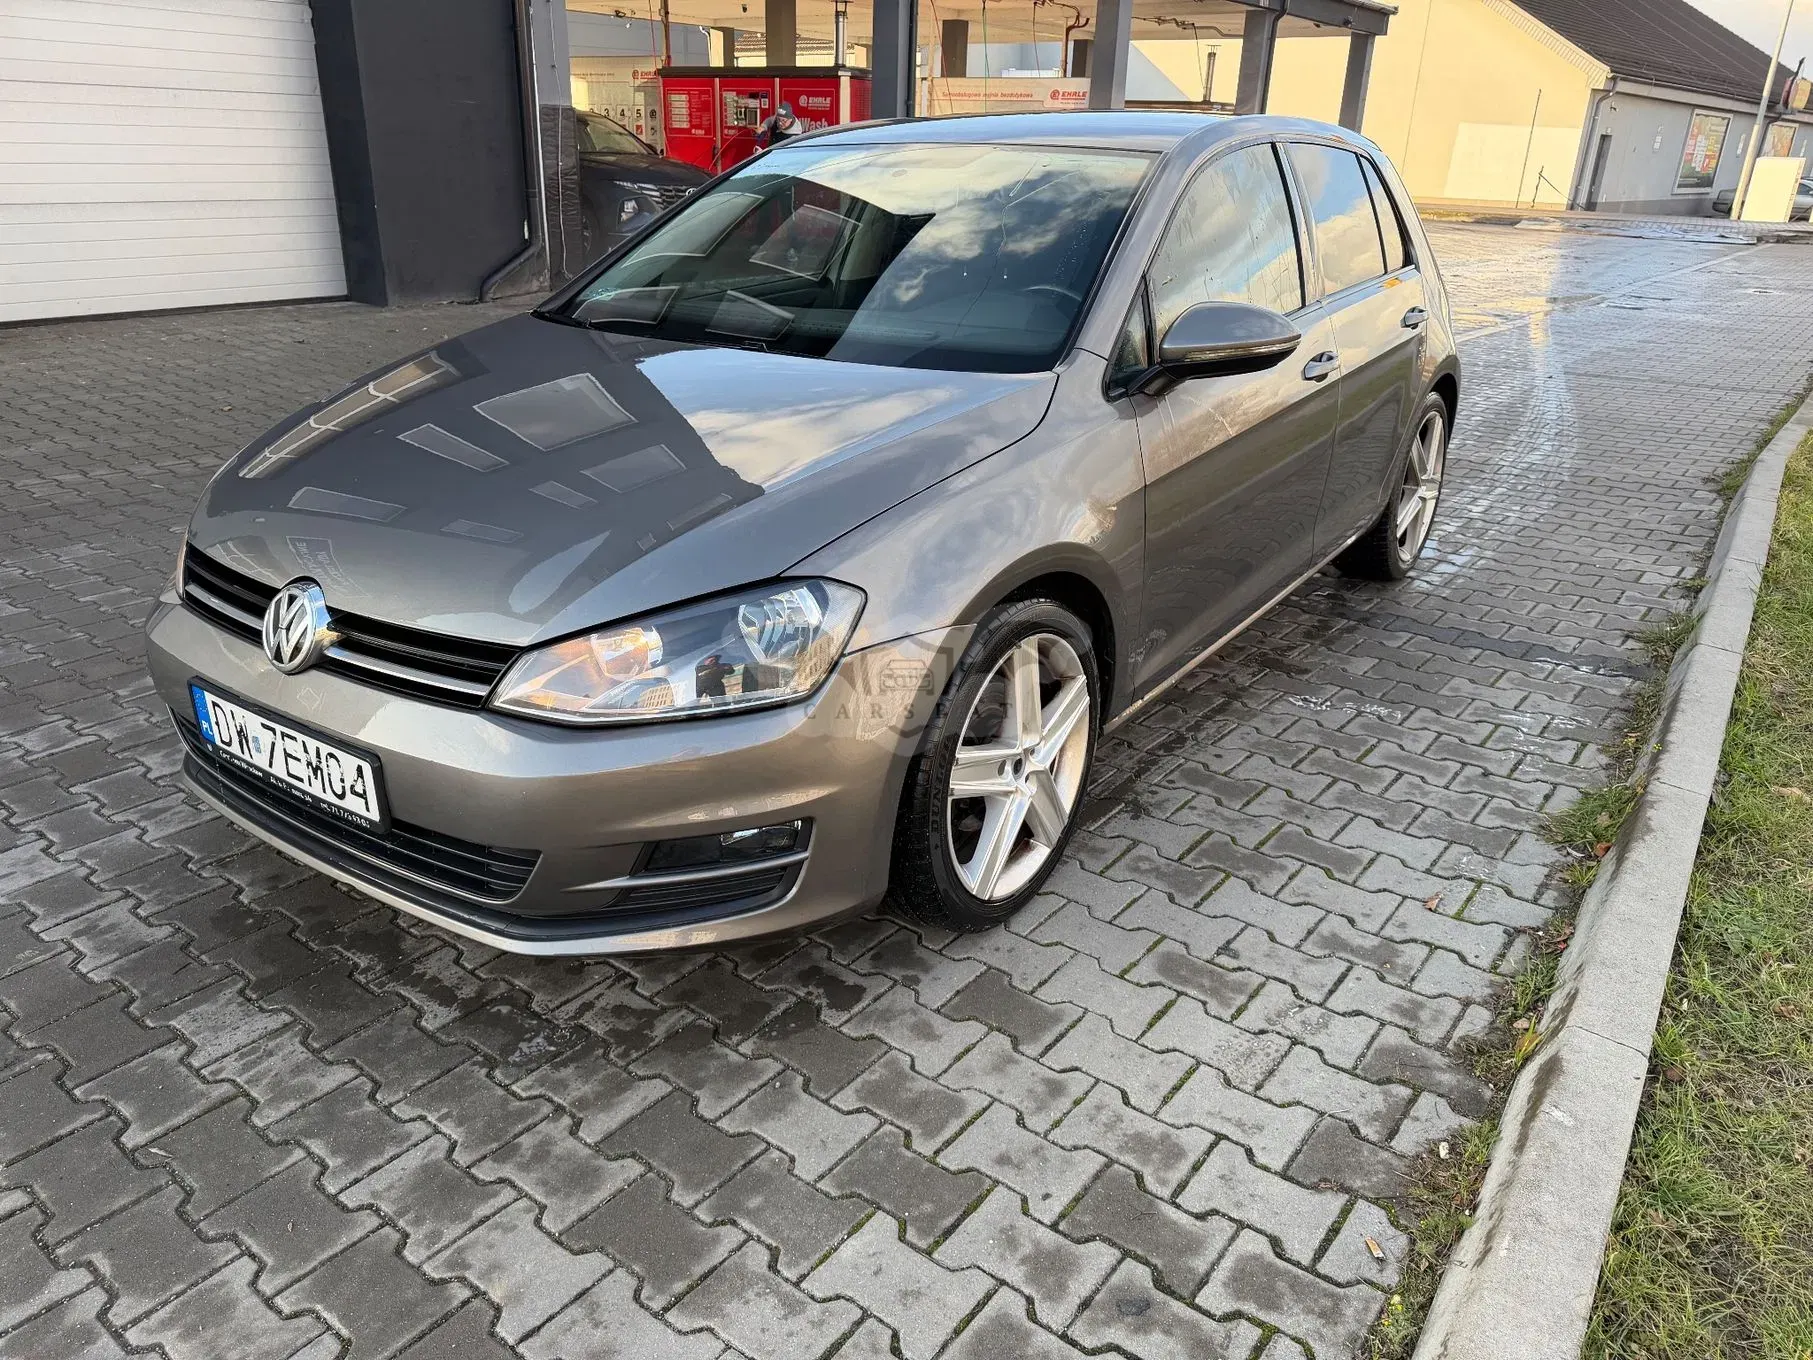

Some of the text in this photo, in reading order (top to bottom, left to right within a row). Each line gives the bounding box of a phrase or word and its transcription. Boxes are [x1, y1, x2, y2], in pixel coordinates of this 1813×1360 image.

[1061, 90, 1088, 98] EHRLE
[604, 107, 610, 117] 3
[619, 108, 625, 117] 4
[635, 108, 641, 118] 5
[201, 719, 213, 736] PL
